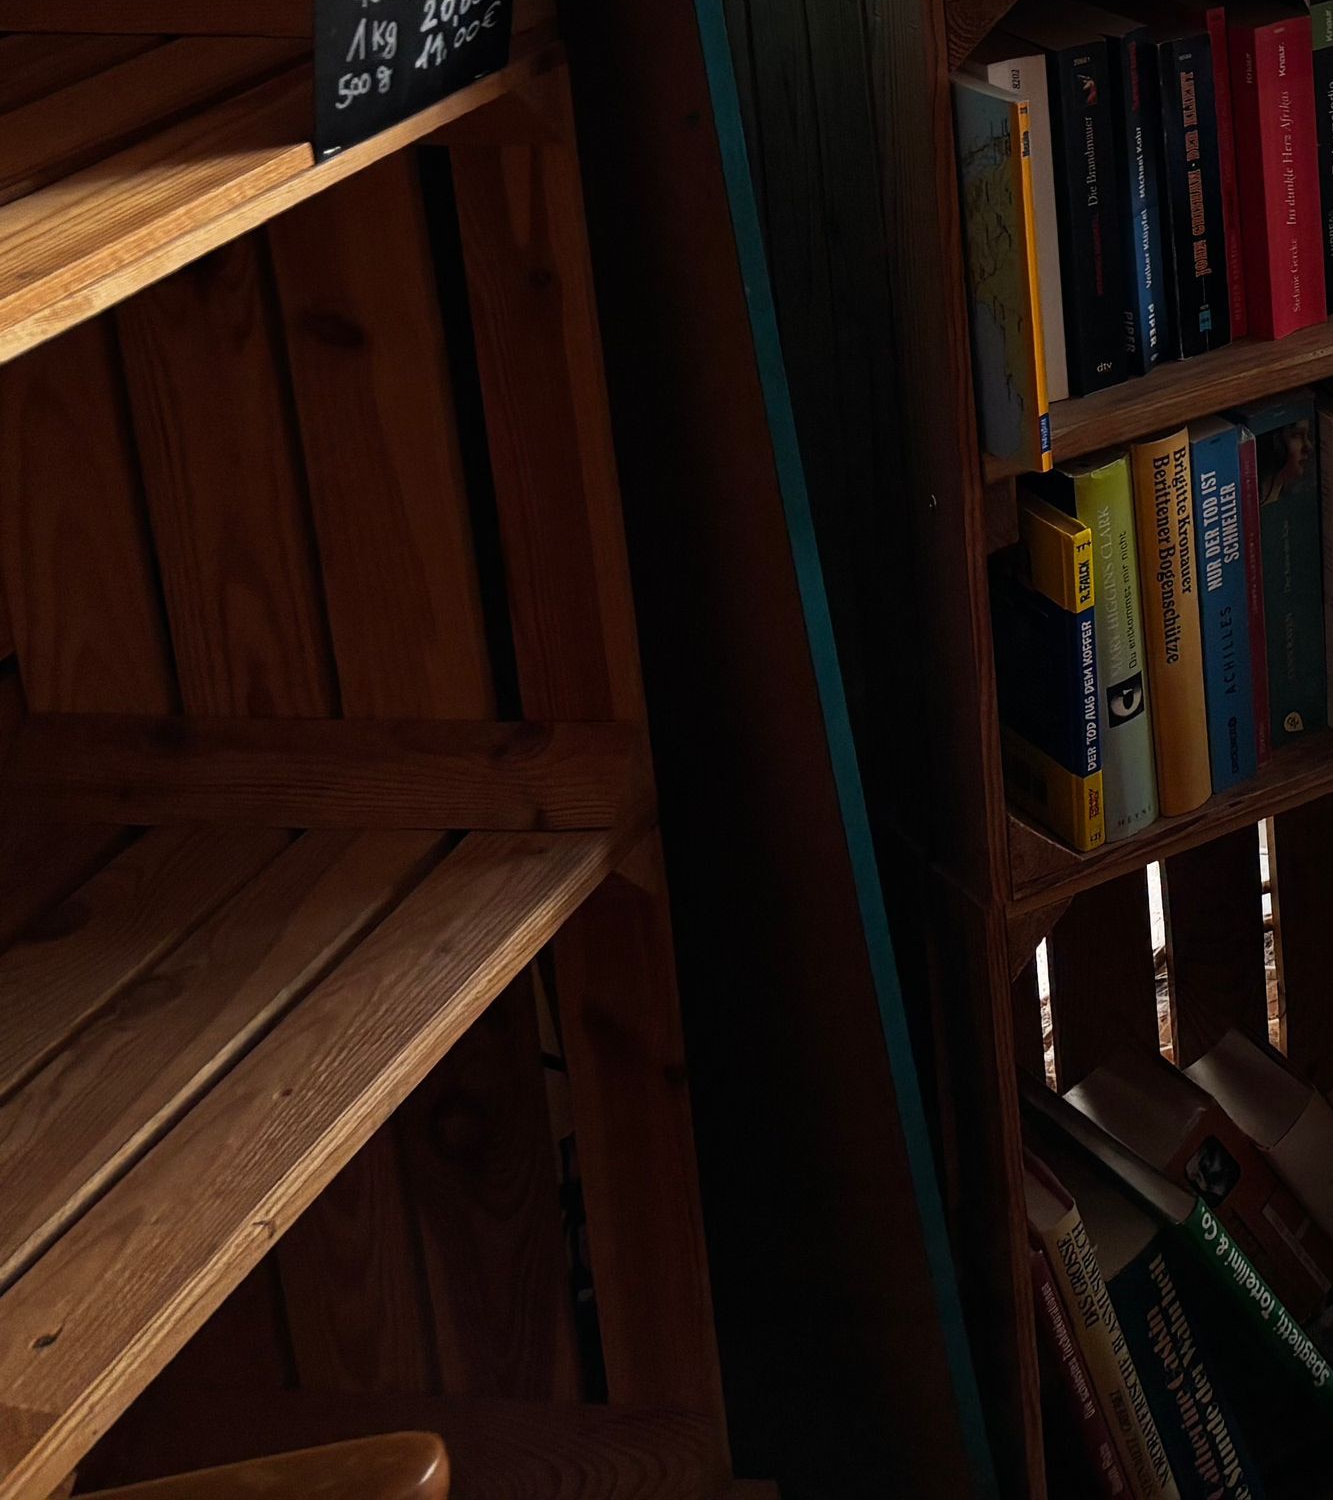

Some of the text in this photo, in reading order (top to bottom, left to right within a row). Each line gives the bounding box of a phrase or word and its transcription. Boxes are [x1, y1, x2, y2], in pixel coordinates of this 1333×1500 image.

[1279, 90, 1292, 131] Afrikas
[1084, 116, 1099, 206] Die Brandmauer
[1135, 125, 1146, 198] Michael Kobr
[1280, 134, 1295, 164] Herz
[1282, 167, 1297, 206] dunkle
[1139, 208, 1151, 250] Klüpfel
[1289, 275, 1302, 313] Stefanie
[1117, 531, 1128, 561] nicht
[1172, 447, 1193, 594] Brigitte Kronauer
[1200, 469, 1224, 592] NUR DER TOD IST
[1220, 481, 1241, 564] SCHNELLER
[1152, 454, 1182, 664] Berittener Bogenschütze
[1097, 505, 1123, 676] MARY HIGGINS CLARK
[1120, 584, 1137, 650] entkommst
[1080, 620, 1093, 666] KOFFER
[1127, 651, 1139, 670] Du
[1218, 605, 1238, 695] ACHILLES
[1082, 668, 1094, 693] DEM
[1082, 696, 1096, 721] AUS
[1083, 722, 1098, 742] TOD
[1084, 746, 1098, 772] DER
[1057, 1232, 1101, 1329] DAS GROSSE
[1199, 1205, 1332, 1388] Spaghetti, Tortellini & Co.
[1149, 1251, 1242, 1488] Stunde der Wahrheit
